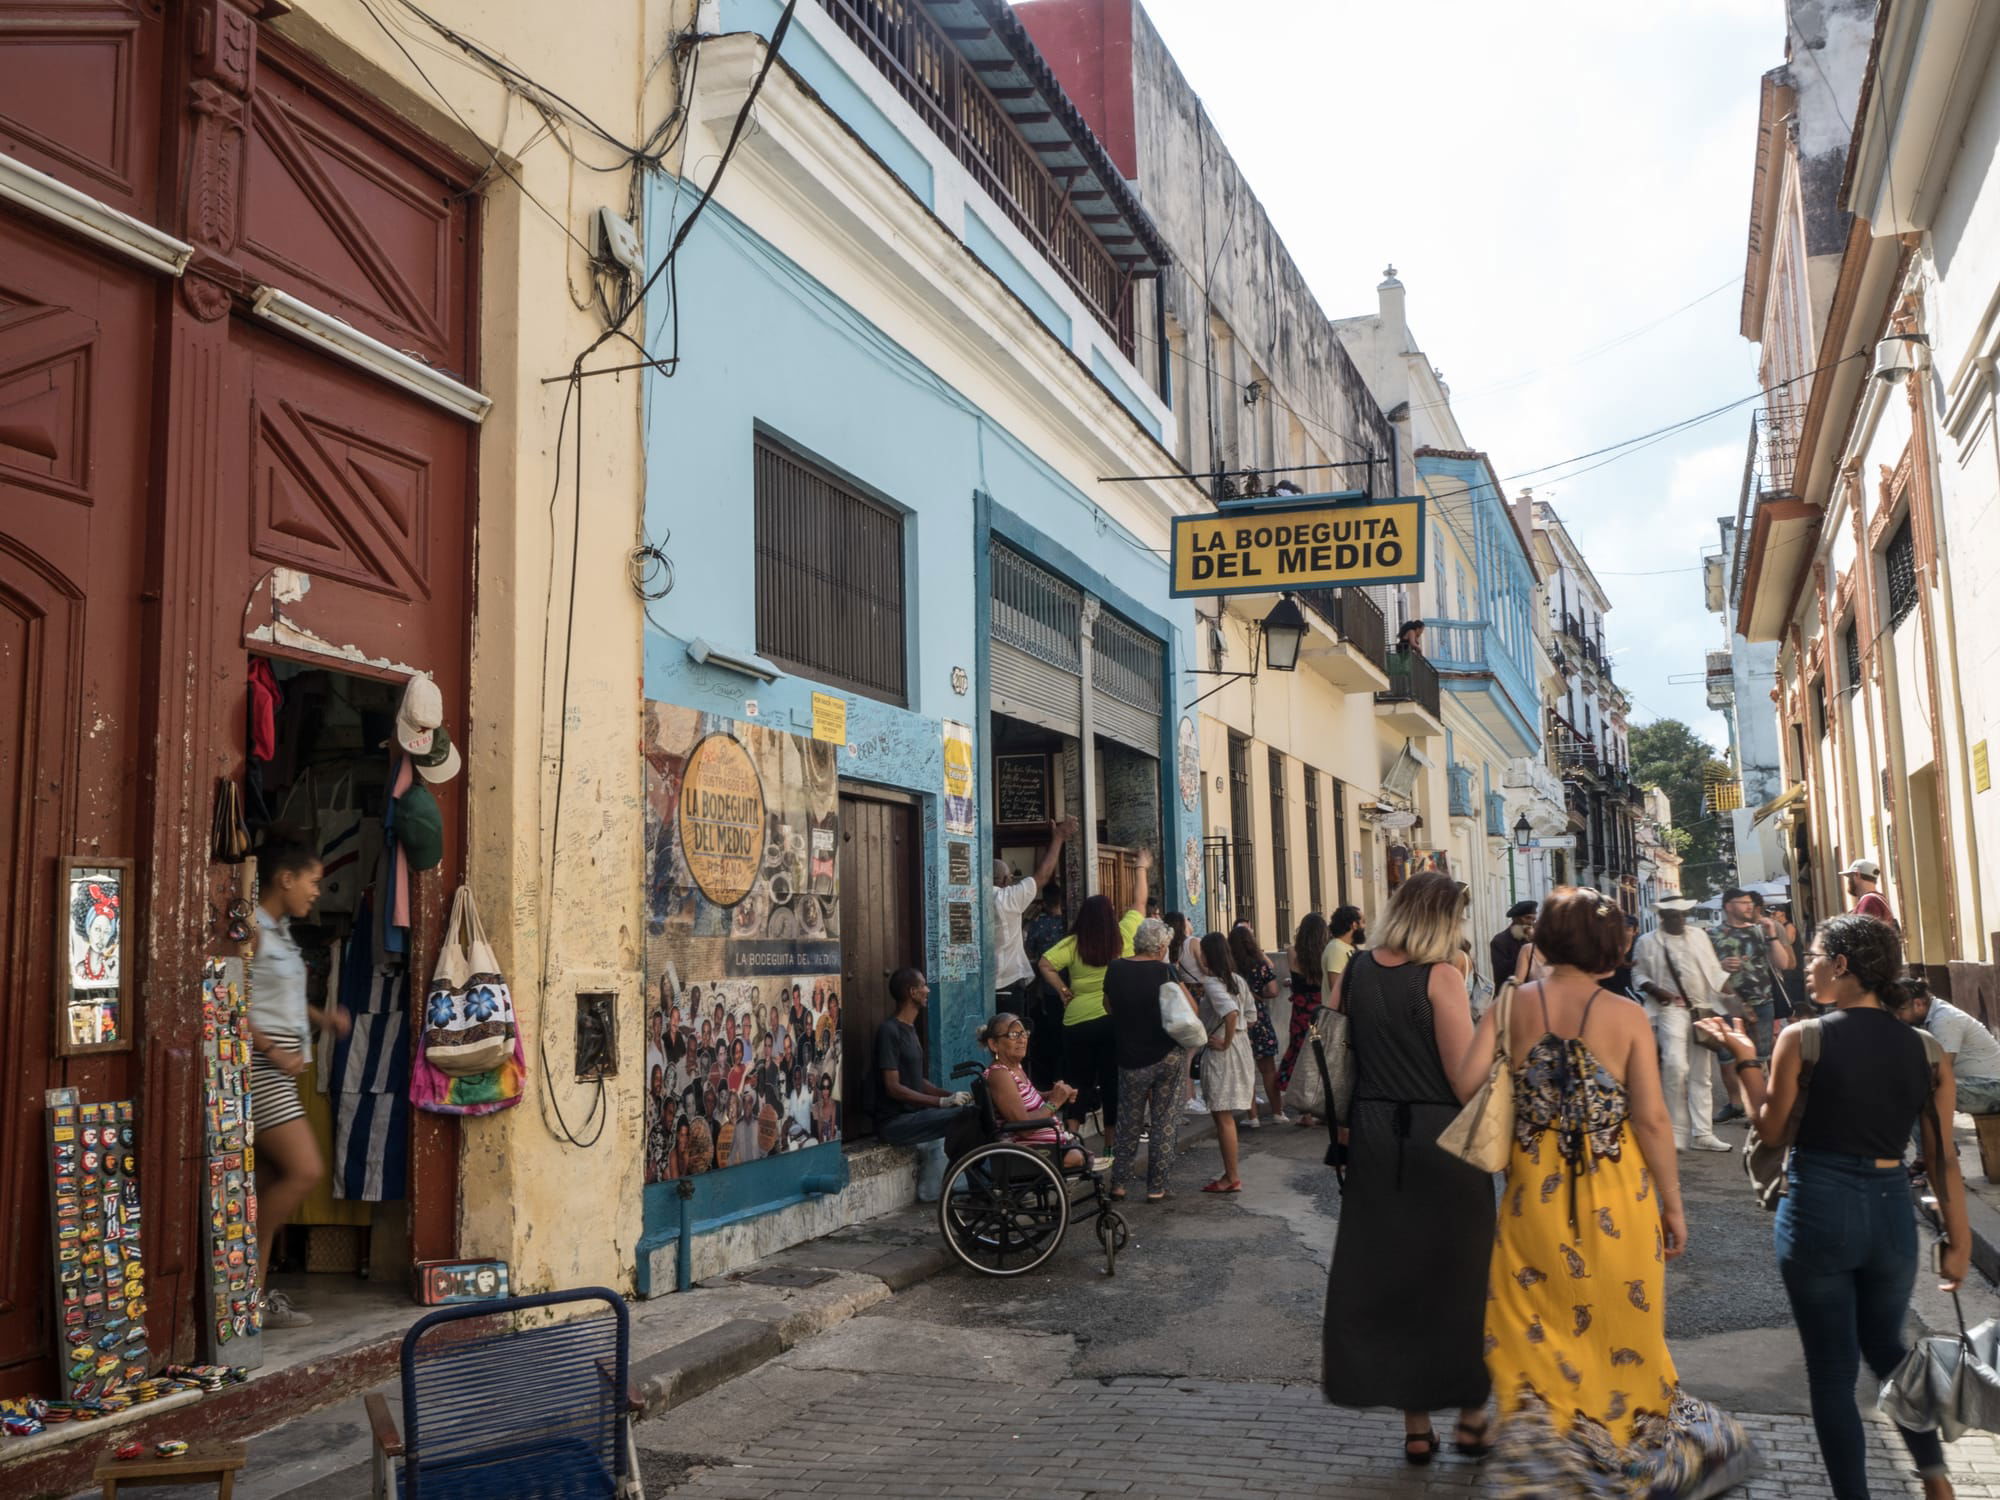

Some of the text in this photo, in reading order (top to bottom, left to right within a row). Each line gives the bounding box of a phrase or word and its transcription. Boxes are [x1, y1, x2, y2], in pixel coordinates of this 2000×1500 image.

[1193, 518, 1399, 553] LA BODEGUITA
[1192, 541, 1403, 580] DEL MEDIO
[686, 788, 759, 825] LA BODEGUITA
[694, 823, 752, 855] DEL MEDIO
[736, 952, 747, 966] LA
[749, 952, 794, 966] BODEGUITA
[434, 1271, 471, 1297] CHE
